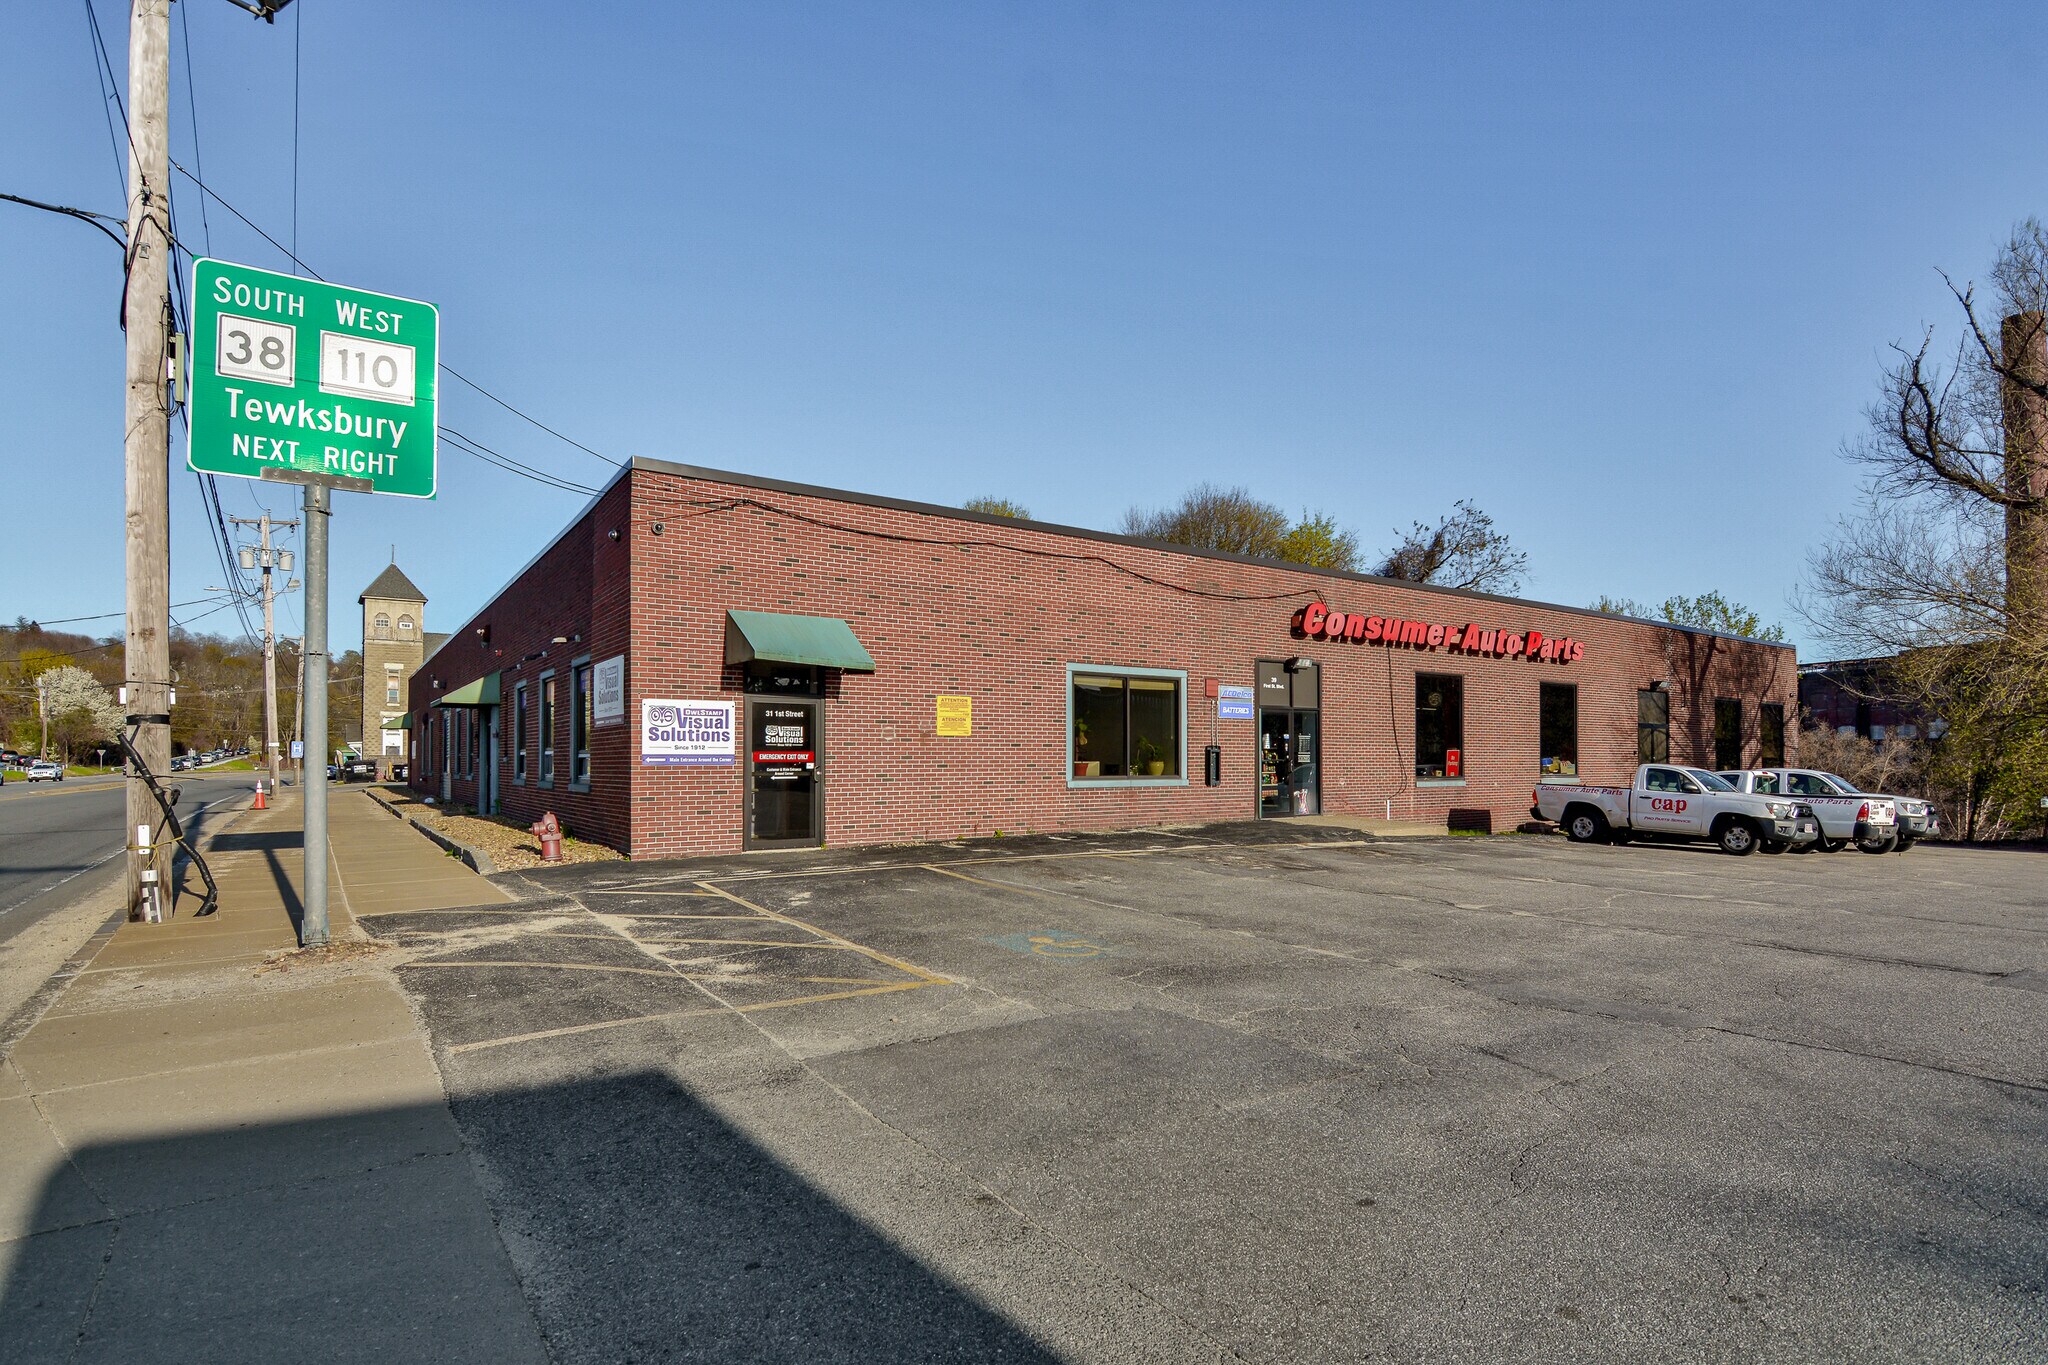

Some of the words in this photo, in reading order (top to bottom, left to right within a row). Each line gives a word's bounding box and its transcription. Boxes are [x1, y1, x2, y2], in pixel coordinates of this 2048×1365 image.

[213, 276, 304, 317] SOUTH
[335, 299, 403, 335] WEST
[226, 330, 285, 370] 38
[338, 348, 398, 388] 110
[225, 387, 408, 449] Tewksbury
[232, 433, 300, 463] NEXT
[324, 446, 398, 476] RIGHT
[1303, 602, 1459, 647] Consumer
[1462, 623, 1521, 655] Auto
[1526, 631, 1585, 661] Parts
[1222, 690, 1252, 698] ACDelco
[675, 707, 729, 729] Visual
[785, 710, 804, 718] Street
[1222, 706, 1249, 714] BATTERIES
[648, 726, 731, 742] Solutions
[765, 735, 804, 743] Solutions
[777, 726, 803, 737] Visual
[1540, 785, 1579, 793] Consumer
[1580, 787, 1600, 795] Auto
[1601, 788, 1623, 796] Parts
[1651, 797, 1687, 814] cap
[1826, 798, 1854, 806] Parts
